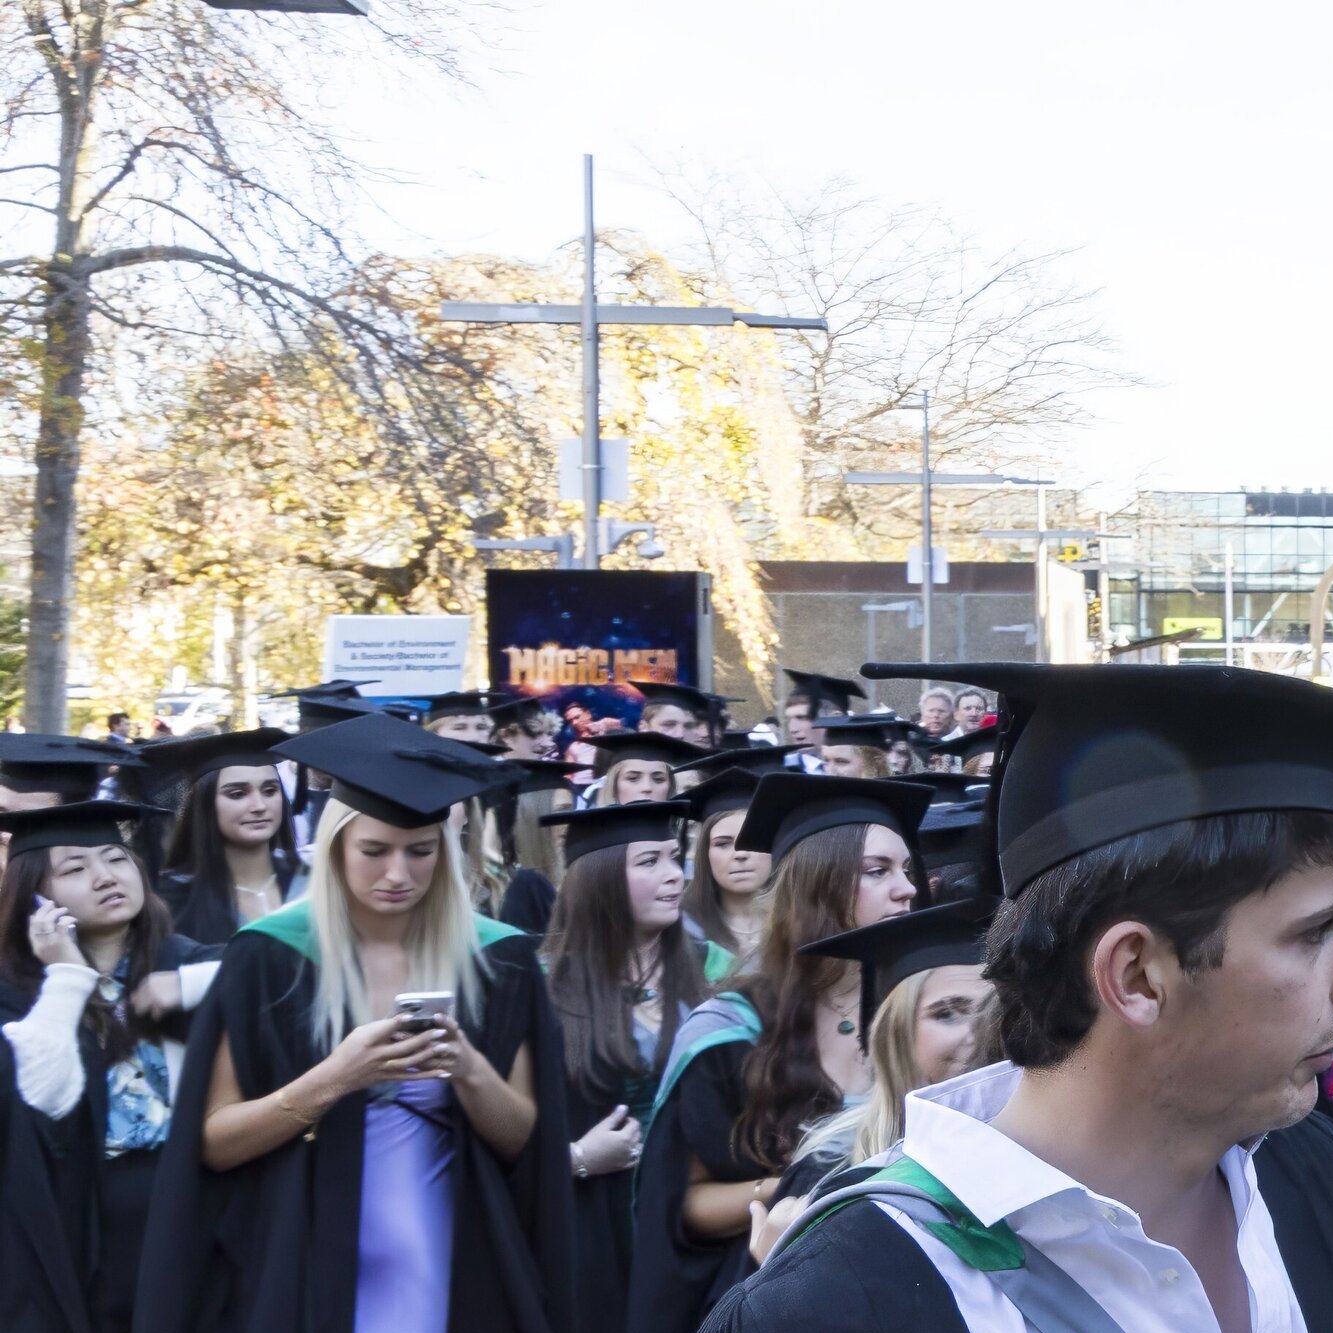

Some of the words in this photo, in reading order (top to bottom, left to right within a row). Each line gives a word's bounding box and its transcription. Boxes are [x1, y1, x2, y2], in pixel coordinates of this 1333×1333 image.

[343, 640, 384, 648] Bachelor
[387, 640, 396, 648] of
[399, 640, 456, 648] Environment
[351, 652, 357, 660] &
[439, 652, 449, 660] of
[334, 664, 400, 672] Environmental
[405, 664, 461, 672] Management
[614, 649, 677, 685] MEN
